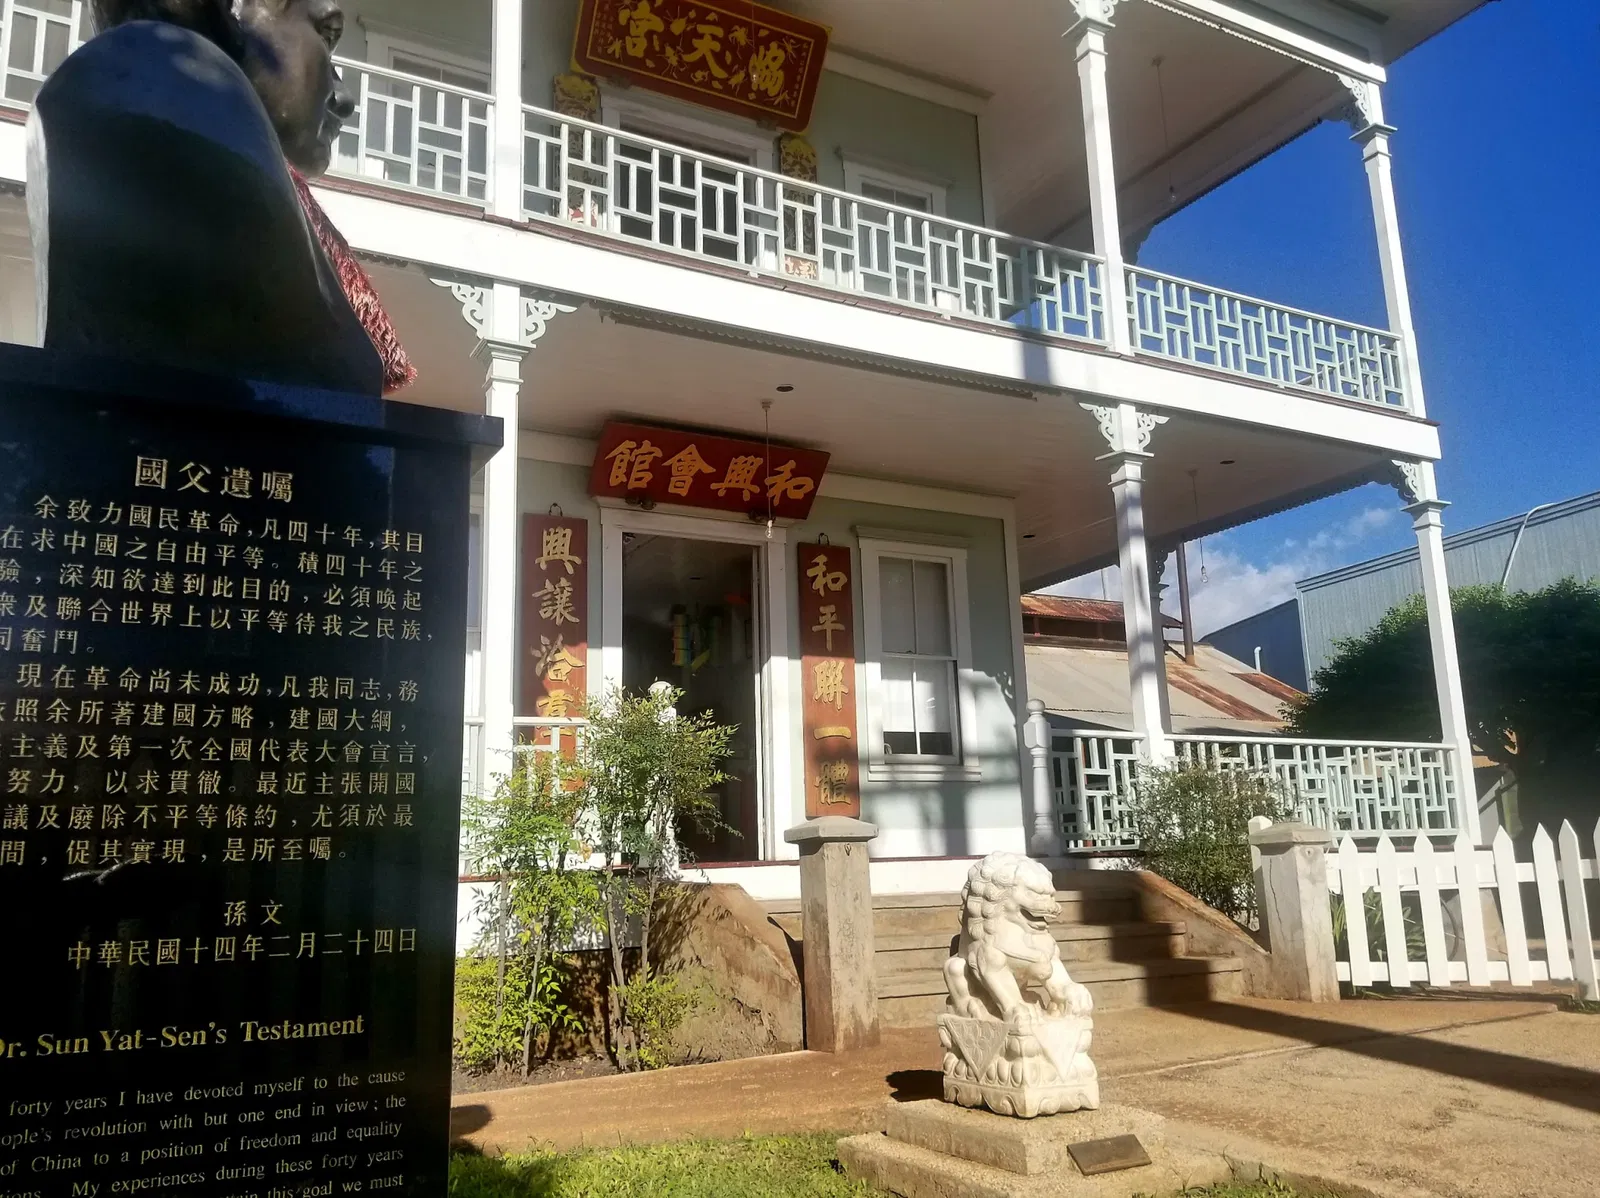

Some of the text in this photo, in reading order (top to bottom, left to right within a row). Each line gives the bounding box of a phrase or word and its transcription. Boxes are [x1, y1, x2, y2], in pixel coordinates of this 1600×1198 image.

[135, 456, 294, 503] 國父遺囑
[224, 899, 284, 926] 孫文
[68, 928, 417, 970] 中華民國十四年二月二十四日
[37, 1032, 89, 1056] Sun
[240, 1015, 365, 1041] Testament
[9, 1070, 406, 1118] forty years I have devoted myself to the cause
[0, 1127, 52, 1149] ople's
[64, 1119, 147, 1139] revolution
[160, 1114, 193, 1129] with
[204, 1110, 228, 1126] but
[238, 1109, 265, 1123] one
[275, 1104, 301, 1119] end
[312, 1102, 324, 1116] in
[386, 1094, 406, 1109] the
[0, 1120, 402, 1175] of China to a position of freedom and equality
[72, 1182, 100, 1198] My
[111, 1169, 205, 1194] experiences
[216, 1163, 265, 1182] during
[276, 1158, 312, 1175] these
[322, 1154, 357, 1170] forty
[367, 1149, 403, 1167] years
[303, 1179, 332, 1198] goal
[342, 1178, 361, 1192] we
[369, 1173, 403, 1190] must
